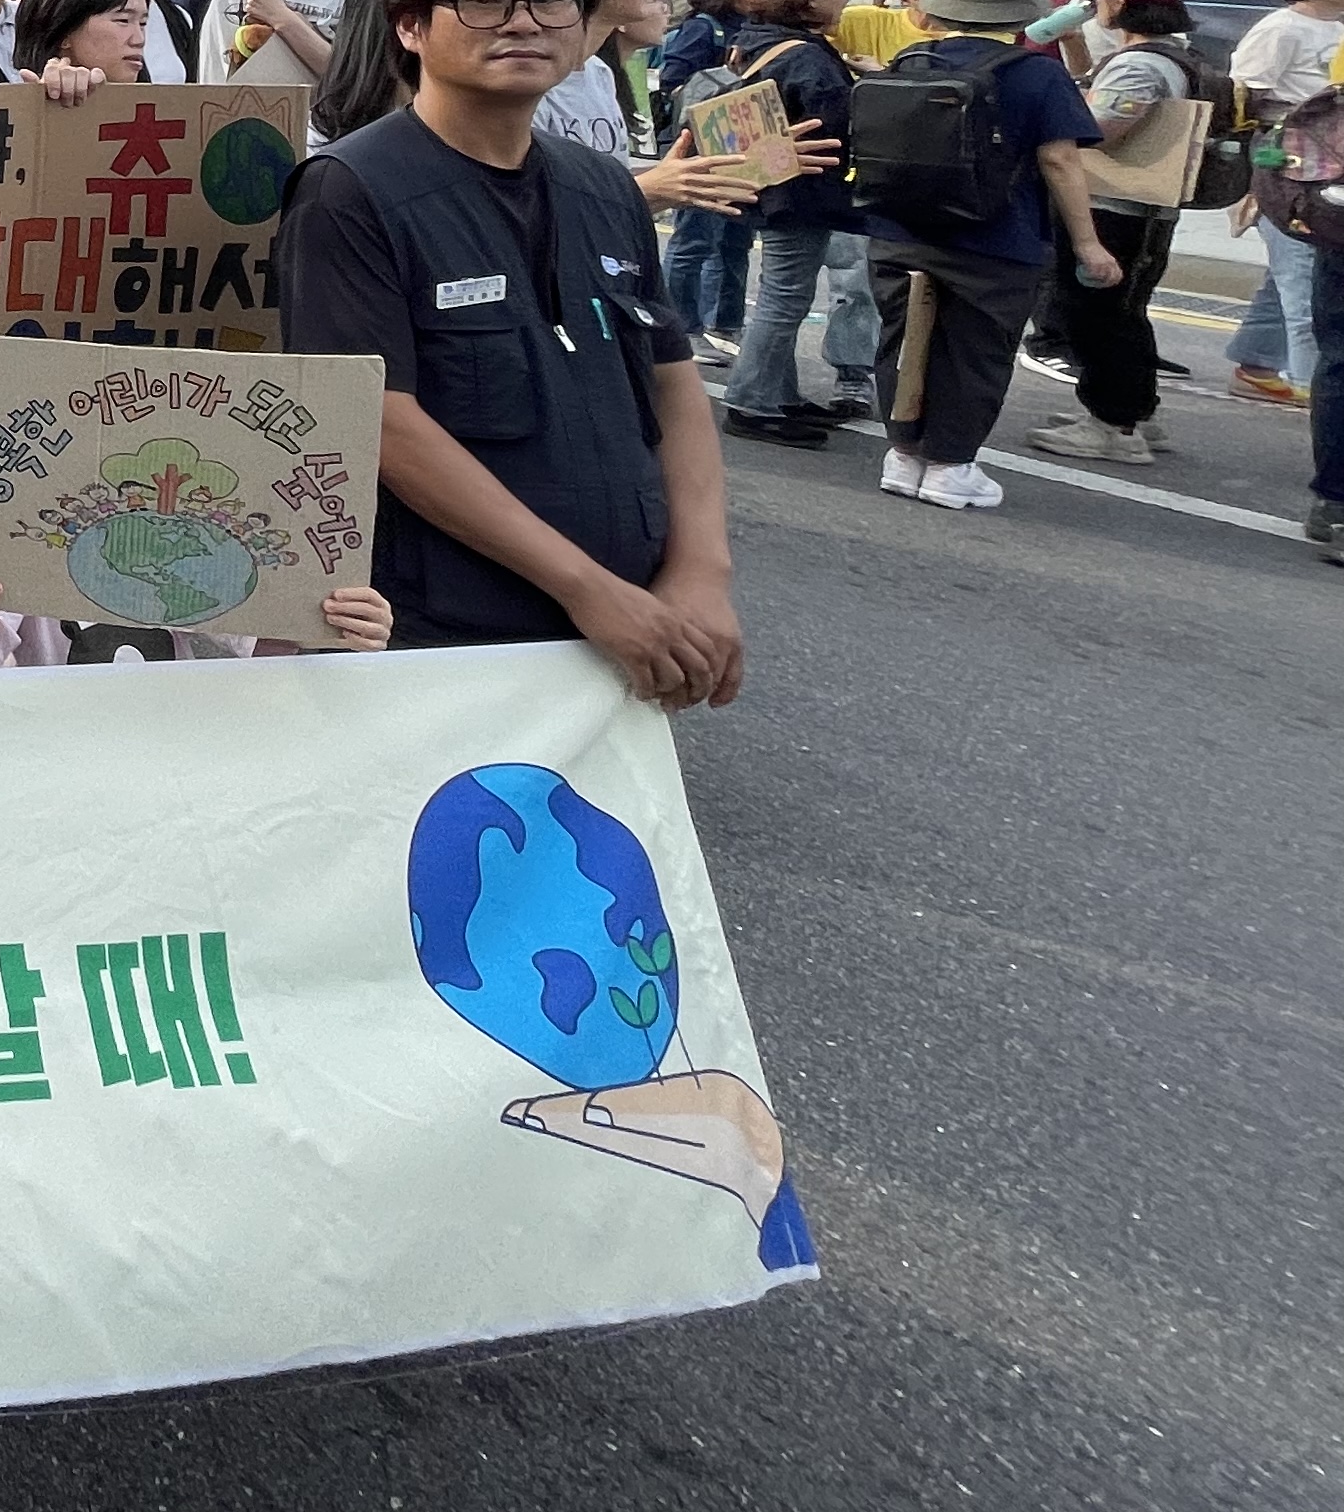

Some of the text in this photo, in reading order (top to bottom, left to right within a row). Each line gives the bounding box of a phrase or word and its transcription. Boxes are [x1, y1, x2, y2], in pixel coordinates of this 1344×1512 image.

[68, 368, 232, 426] 어린이가
[272, 452, 363, 576] 싶어요
[76, 931, 258, 1090] 때!
